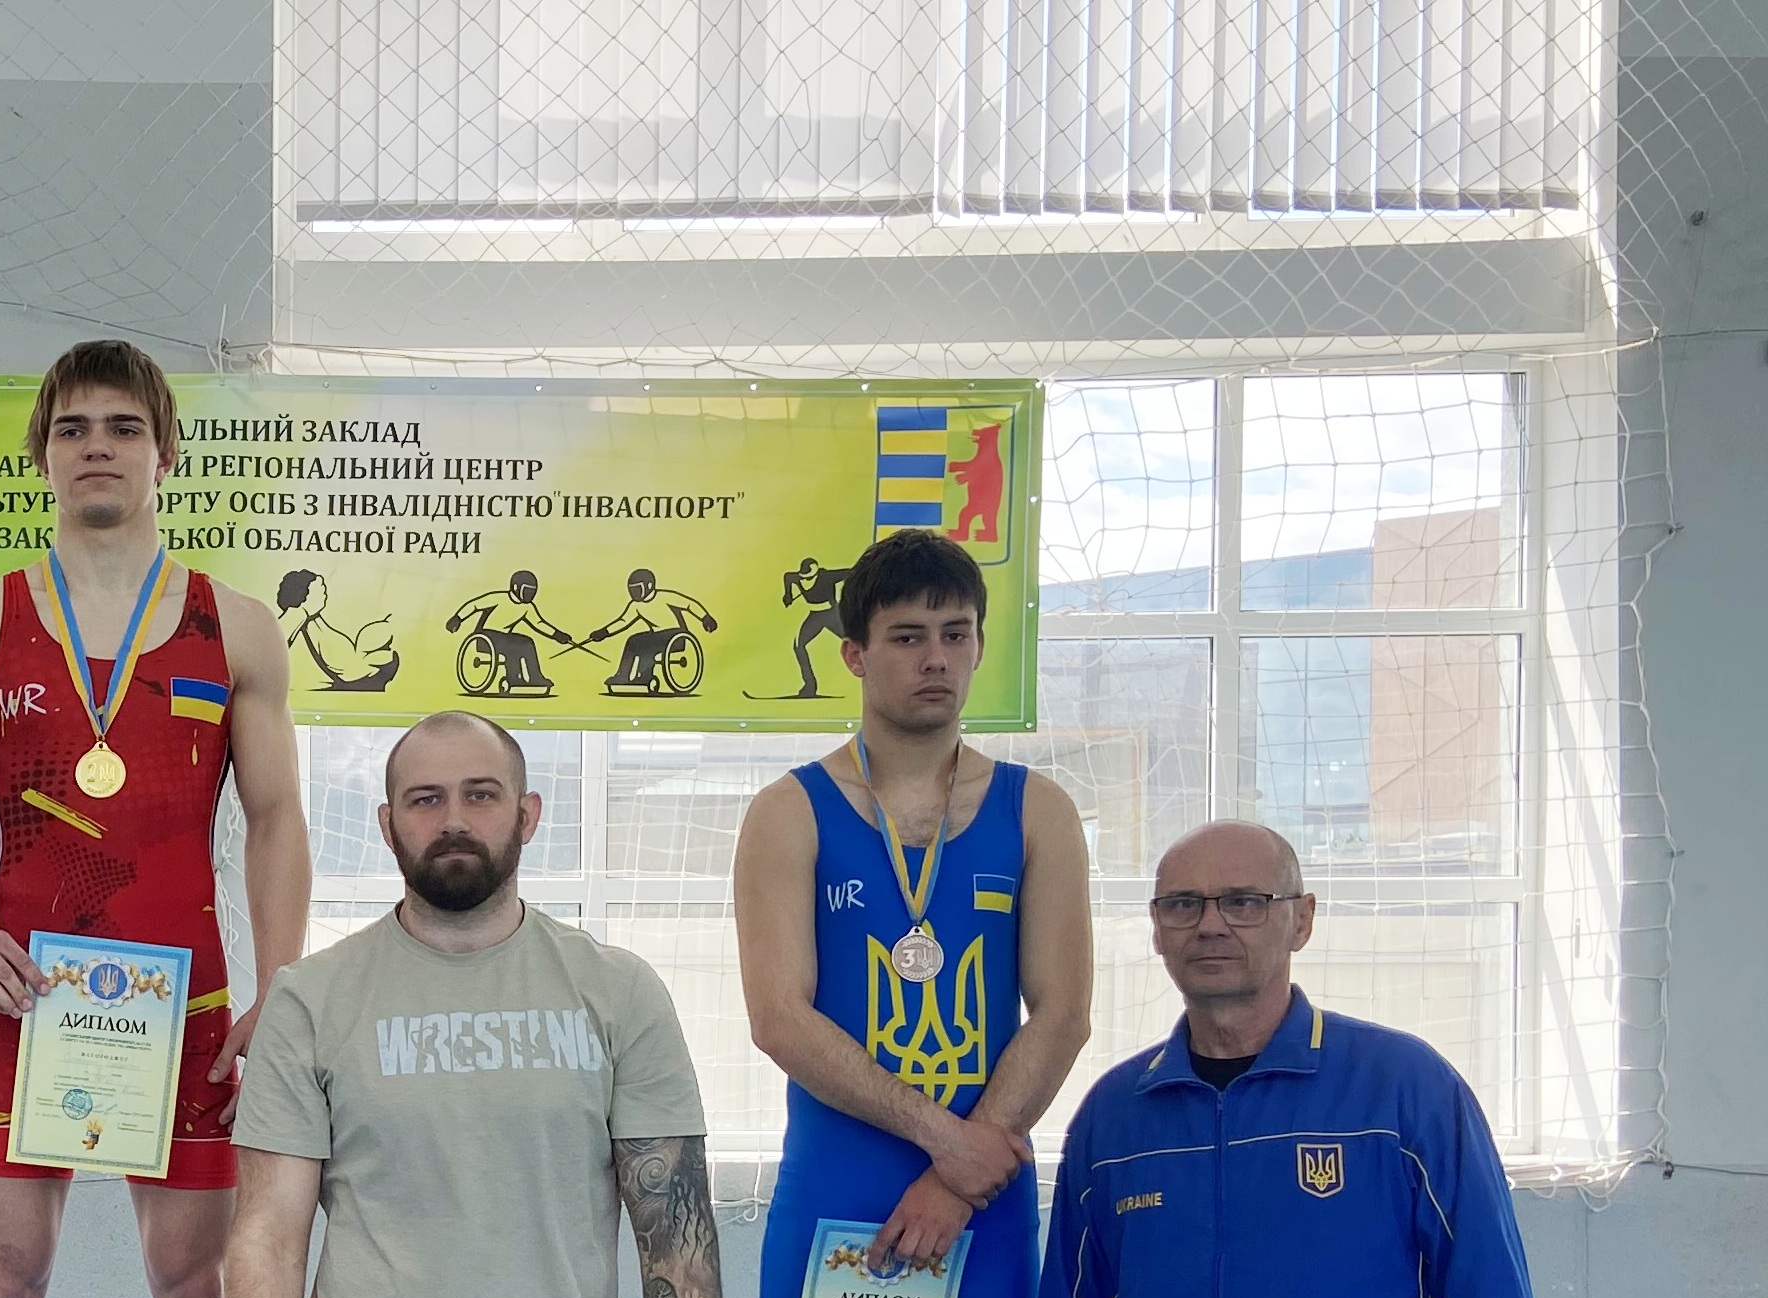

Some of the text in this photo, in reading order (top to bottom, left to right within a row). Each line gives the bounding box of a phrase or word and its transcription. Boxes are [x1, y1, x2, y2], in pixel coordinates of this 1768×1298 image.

[302, 419, 421, 448] ЗАКЛАД
[202, 452, 434, 480] РЕГІОНАЛЬНИЙ
[443, 458, 543, 485] ЦЕНТР
[229, 491, 296, 515] ОСІБ
[304, 493, 318, 516] З
[328, 493, 553, 522] ІНВАЛІДНІСТЮ
[244, 525, 395, 554] ОБЛАСНОЇ
[404, 531, 481, 559] РАДИ
[827, 879, 865, 913] WR
[900, 949, 916, 968] 3
[59, 1012, 147, 1035] ДИПЛОМ
[1116, 1192, 1163, 1215] UKRAINE
